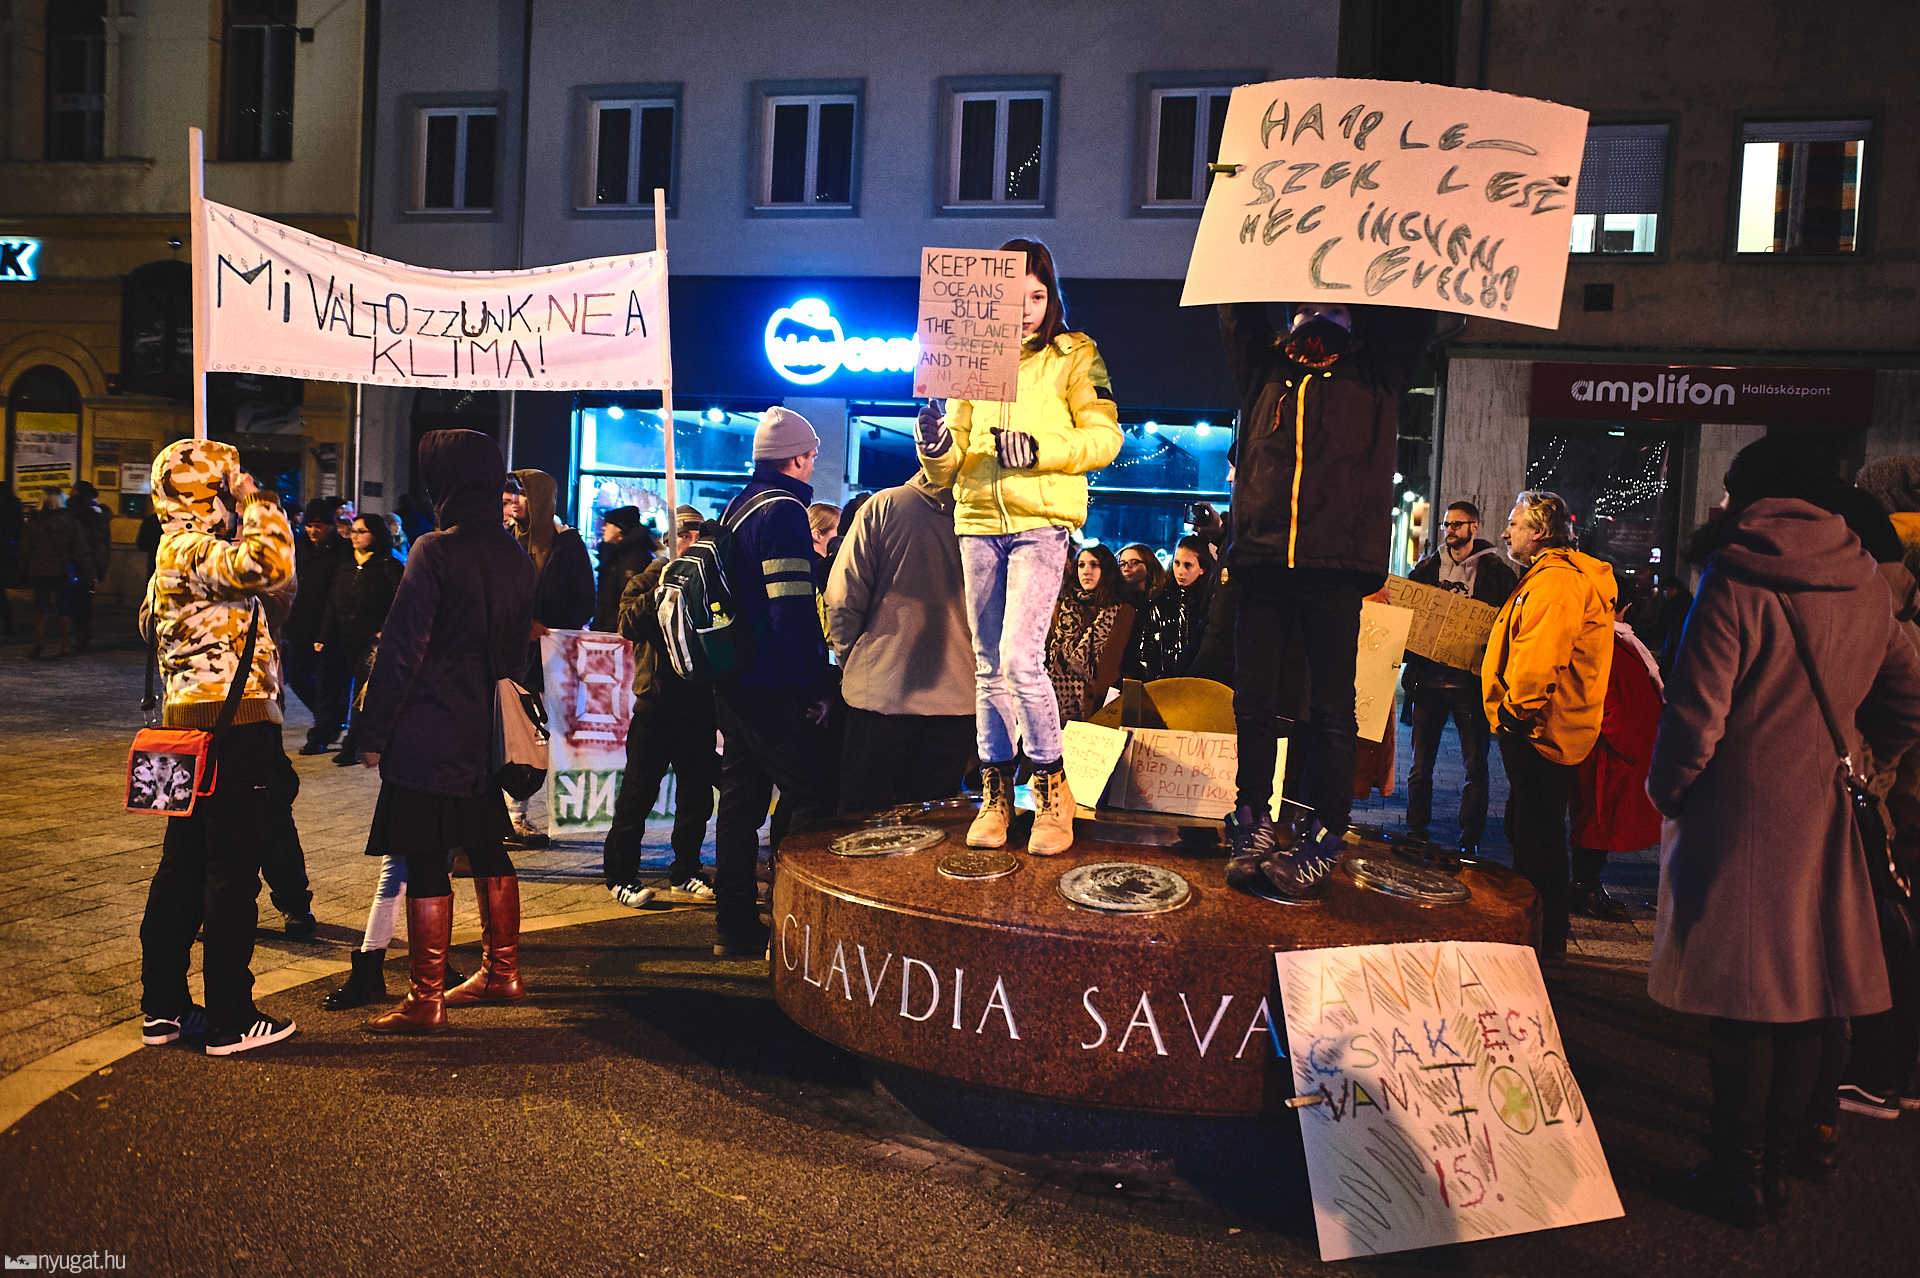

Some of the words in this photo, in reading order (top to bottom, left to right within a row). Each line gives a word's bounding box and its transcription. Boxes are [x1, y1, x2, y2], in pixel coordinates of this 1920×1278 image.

[1261, 98, 1324, 149] HA
[1338, 104, 1384, 150] 18
[1245, 160, 1382, 206] SZEK
[1437, 165, 1568, 216] LESZ
[926, 253, 977, 278] KEEP
[981, 257, 1017, 279] THE
[932, 280, 1004, 300] OCEANS
[547, 292, 616, 337] NE
[625, 289, 647, 338] A
[951, 298, 1001, 321] BLUE
[924, 317, 955, 335] THE
[961, 319, 1021, 339] PLANET
[944, 336, 1004, 356] GREEN
[919, 351, 952, 368] AND
[955, 355, 990, 371] THE
[1571, 373, 1736, 411] amplifon
[1139, 733, 1169, 761] NE
[1174, 765, 1185, 778] A
[781, 912, 1021, 1041] CLAVDIA
[1318, 947, 1498, 1025] ANYA
[1310, 1018, 1461, 1076] CSAK
[1478, 1009, 1545, 1051] EGY
